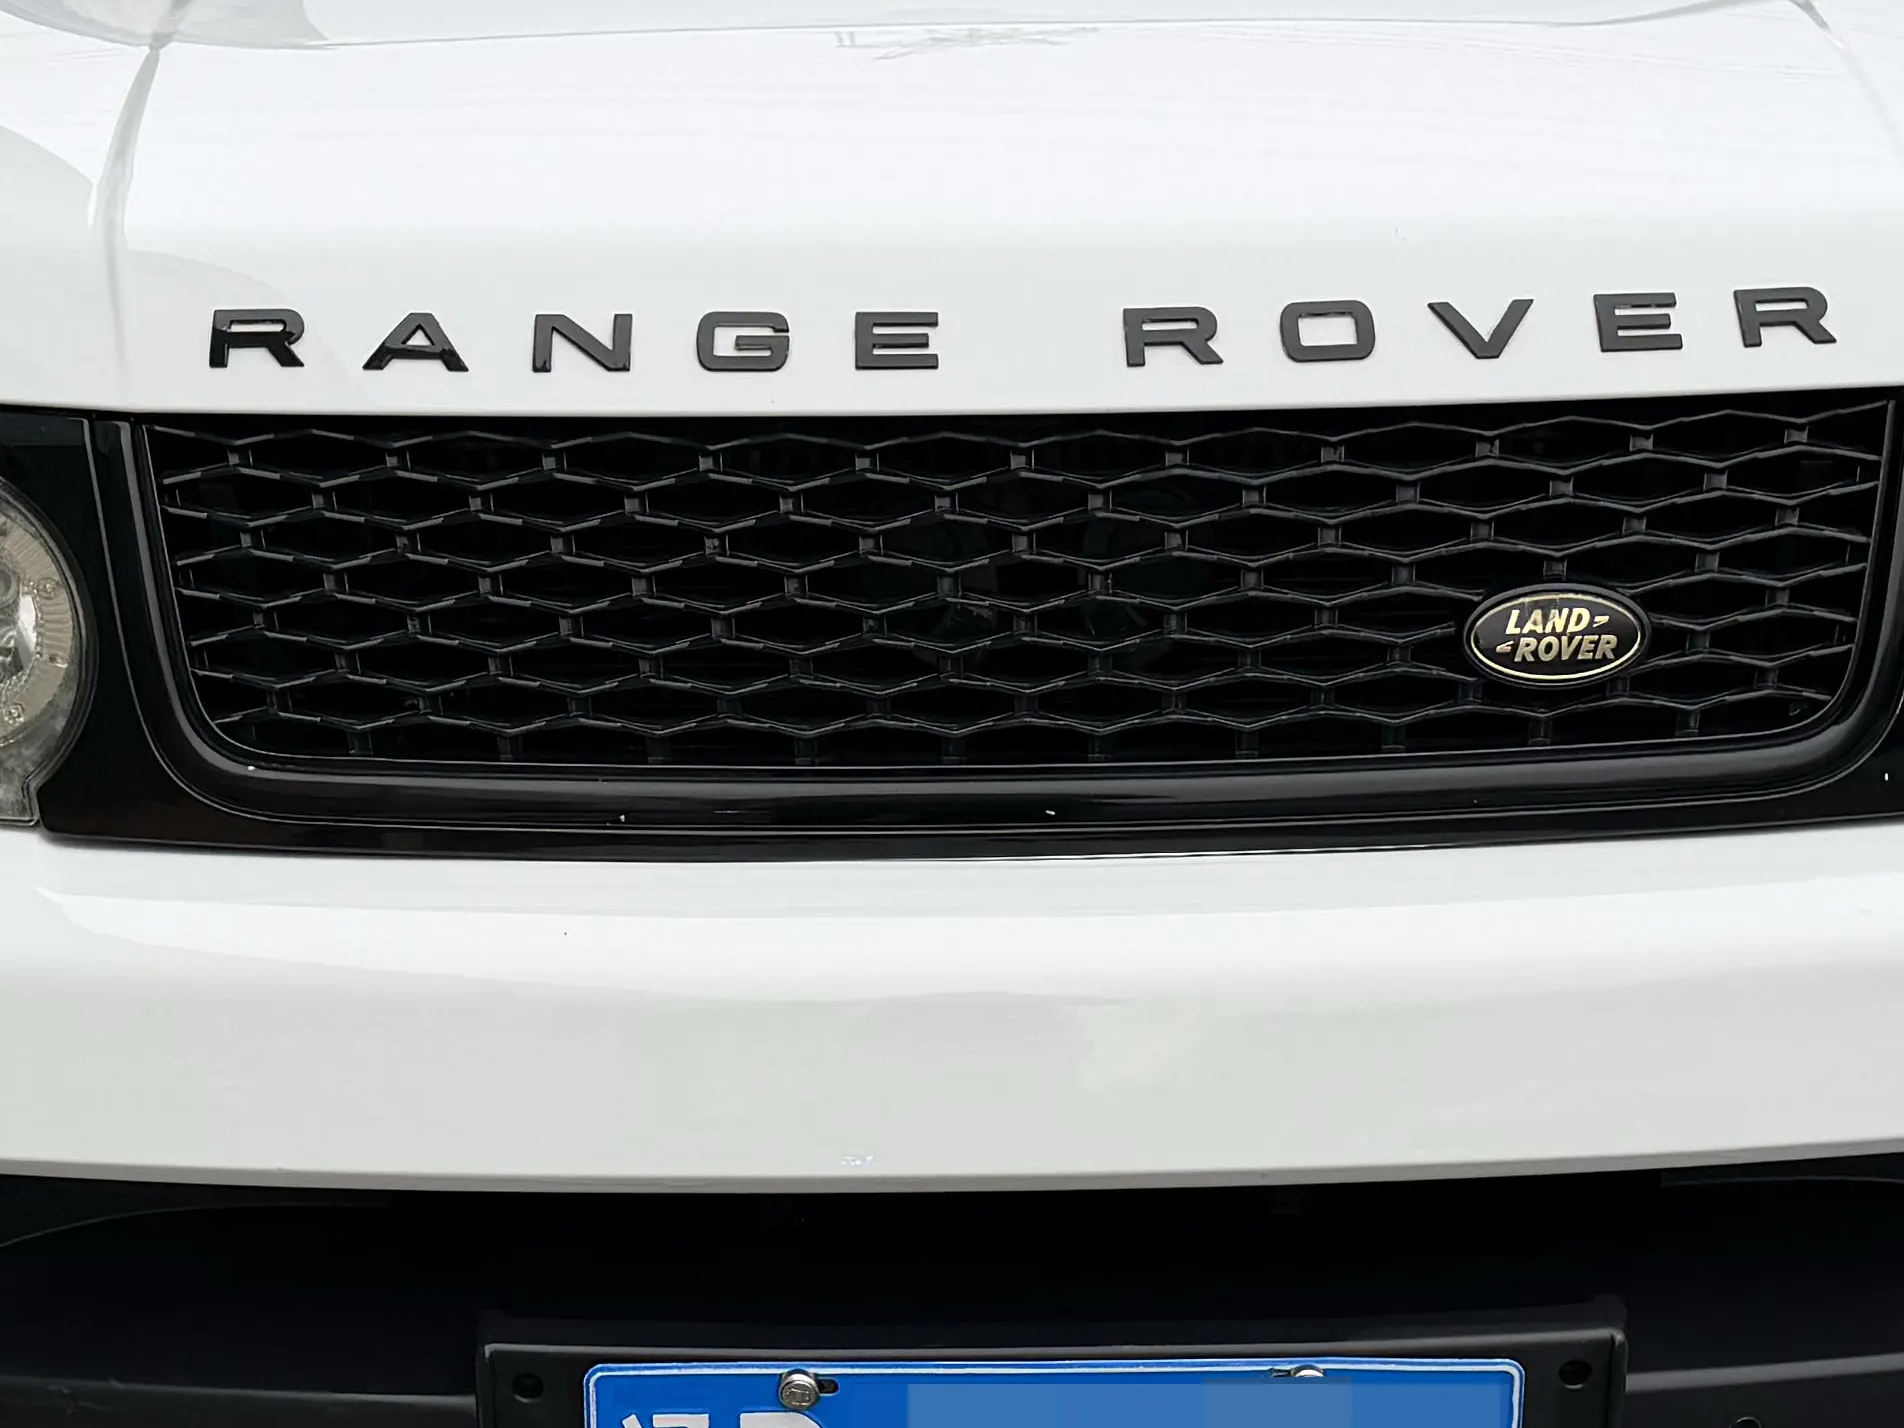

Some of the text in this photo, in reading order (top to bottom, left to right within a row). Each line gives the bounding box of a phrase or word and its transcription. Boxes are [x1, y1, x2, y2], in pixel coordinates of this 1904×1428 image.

[209, 287, 1836, 372] RANGE ROVER
[1505, 607, 1591, 635] LAND
[1514, 634, 1618, 663] ROVER
